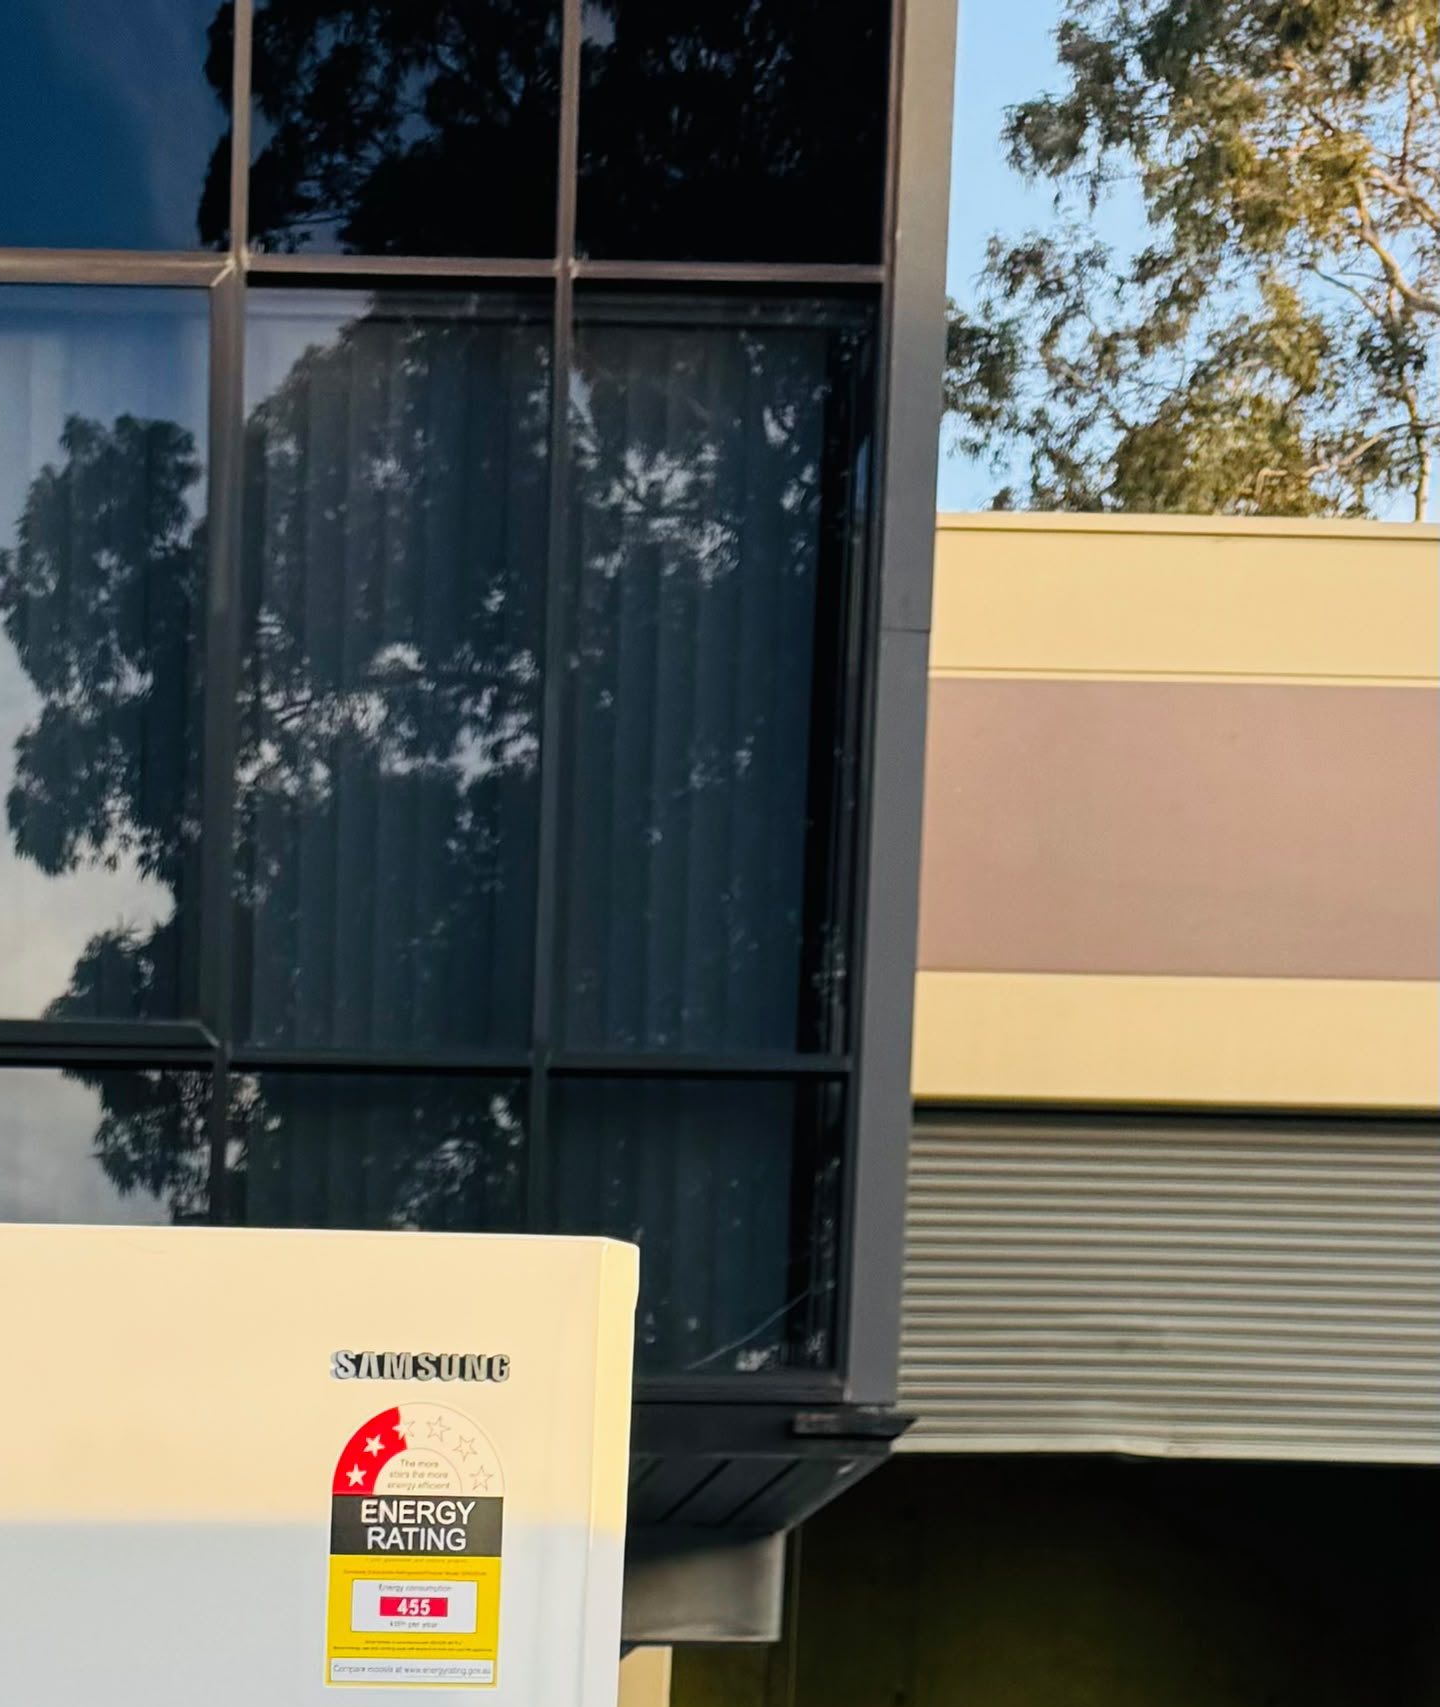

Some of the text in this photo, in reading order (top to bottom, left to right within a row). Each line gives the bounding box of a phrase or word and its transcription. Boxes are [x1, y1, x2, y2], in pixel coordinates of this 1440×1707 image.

[331, 1350, 510, 1382] SAMSUNG
[361, 1499, 475, 1525] ENERGY
[367, 1526, 466, 1551] RATING
[396, 1598, 431, 1616] 455
